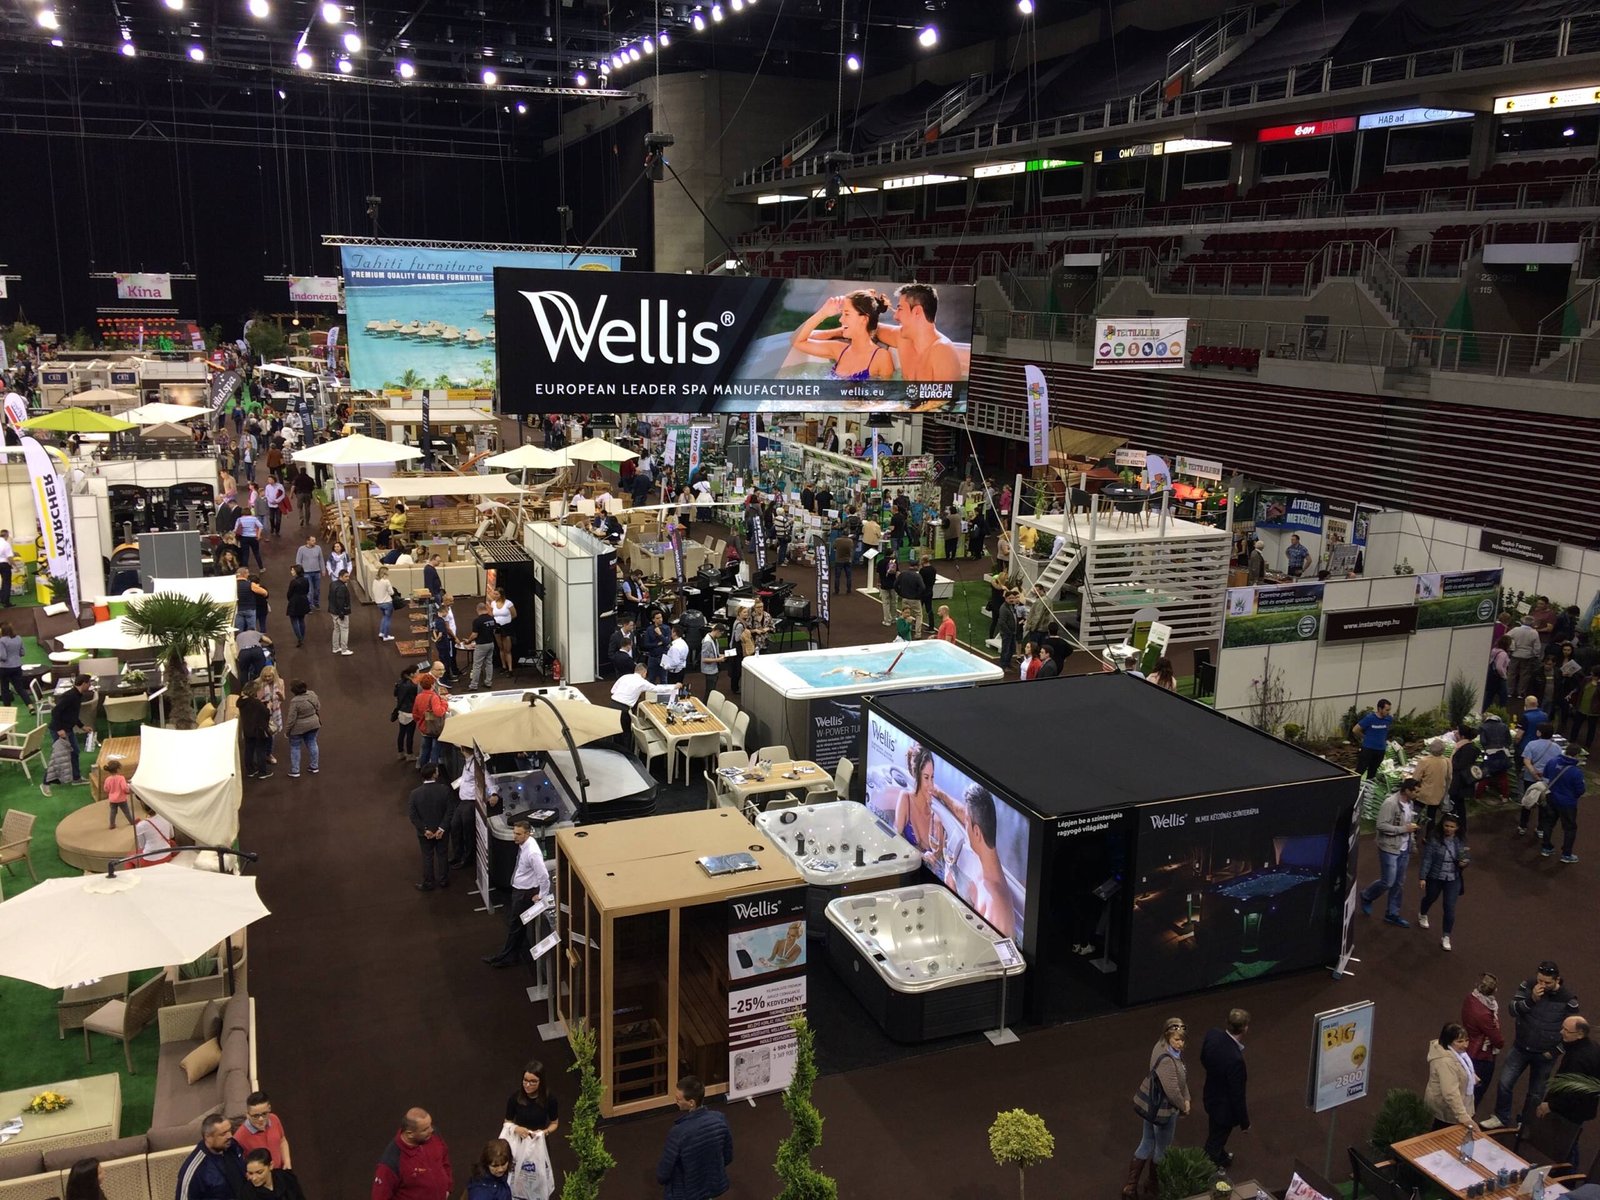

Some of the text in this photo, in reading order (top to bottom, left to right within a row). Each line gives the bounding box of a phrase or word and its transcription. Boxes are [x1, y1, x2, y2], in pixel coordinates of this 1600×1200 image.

[1119, 148, 1135, 158] OMV
[351, 254, 483, 272] Tahiti furniture
[351, 271, 483, 282] PREMIUM QUALITY GARDEN FURNITURE
[291, 291, 337, 301] Indonézia
[535, 383, 820, 396] EUROPEAN LEADER SPA MANUFACTURER
[840, 387, 885, 397] wellis.eu
[919, 383, 953, 391] MADE IN
[919, 390, 953, 399] EUROPE
[1292, 498, 1321, 513] ÁTTÉTELES
[1515, 542, 1532, 551] Ferenc
[1343, 619, 1401, 630] www.instantgyep.hu
[1058, 820, 1078, 829] Lépjen
[1091, 812, 1123, 824] színterápia
[1057, 822, 1109, 838] ragyogó világába!
[730, 996, 765, 1014] -25%
[1323, 1022, 1356, 1051] BIG
